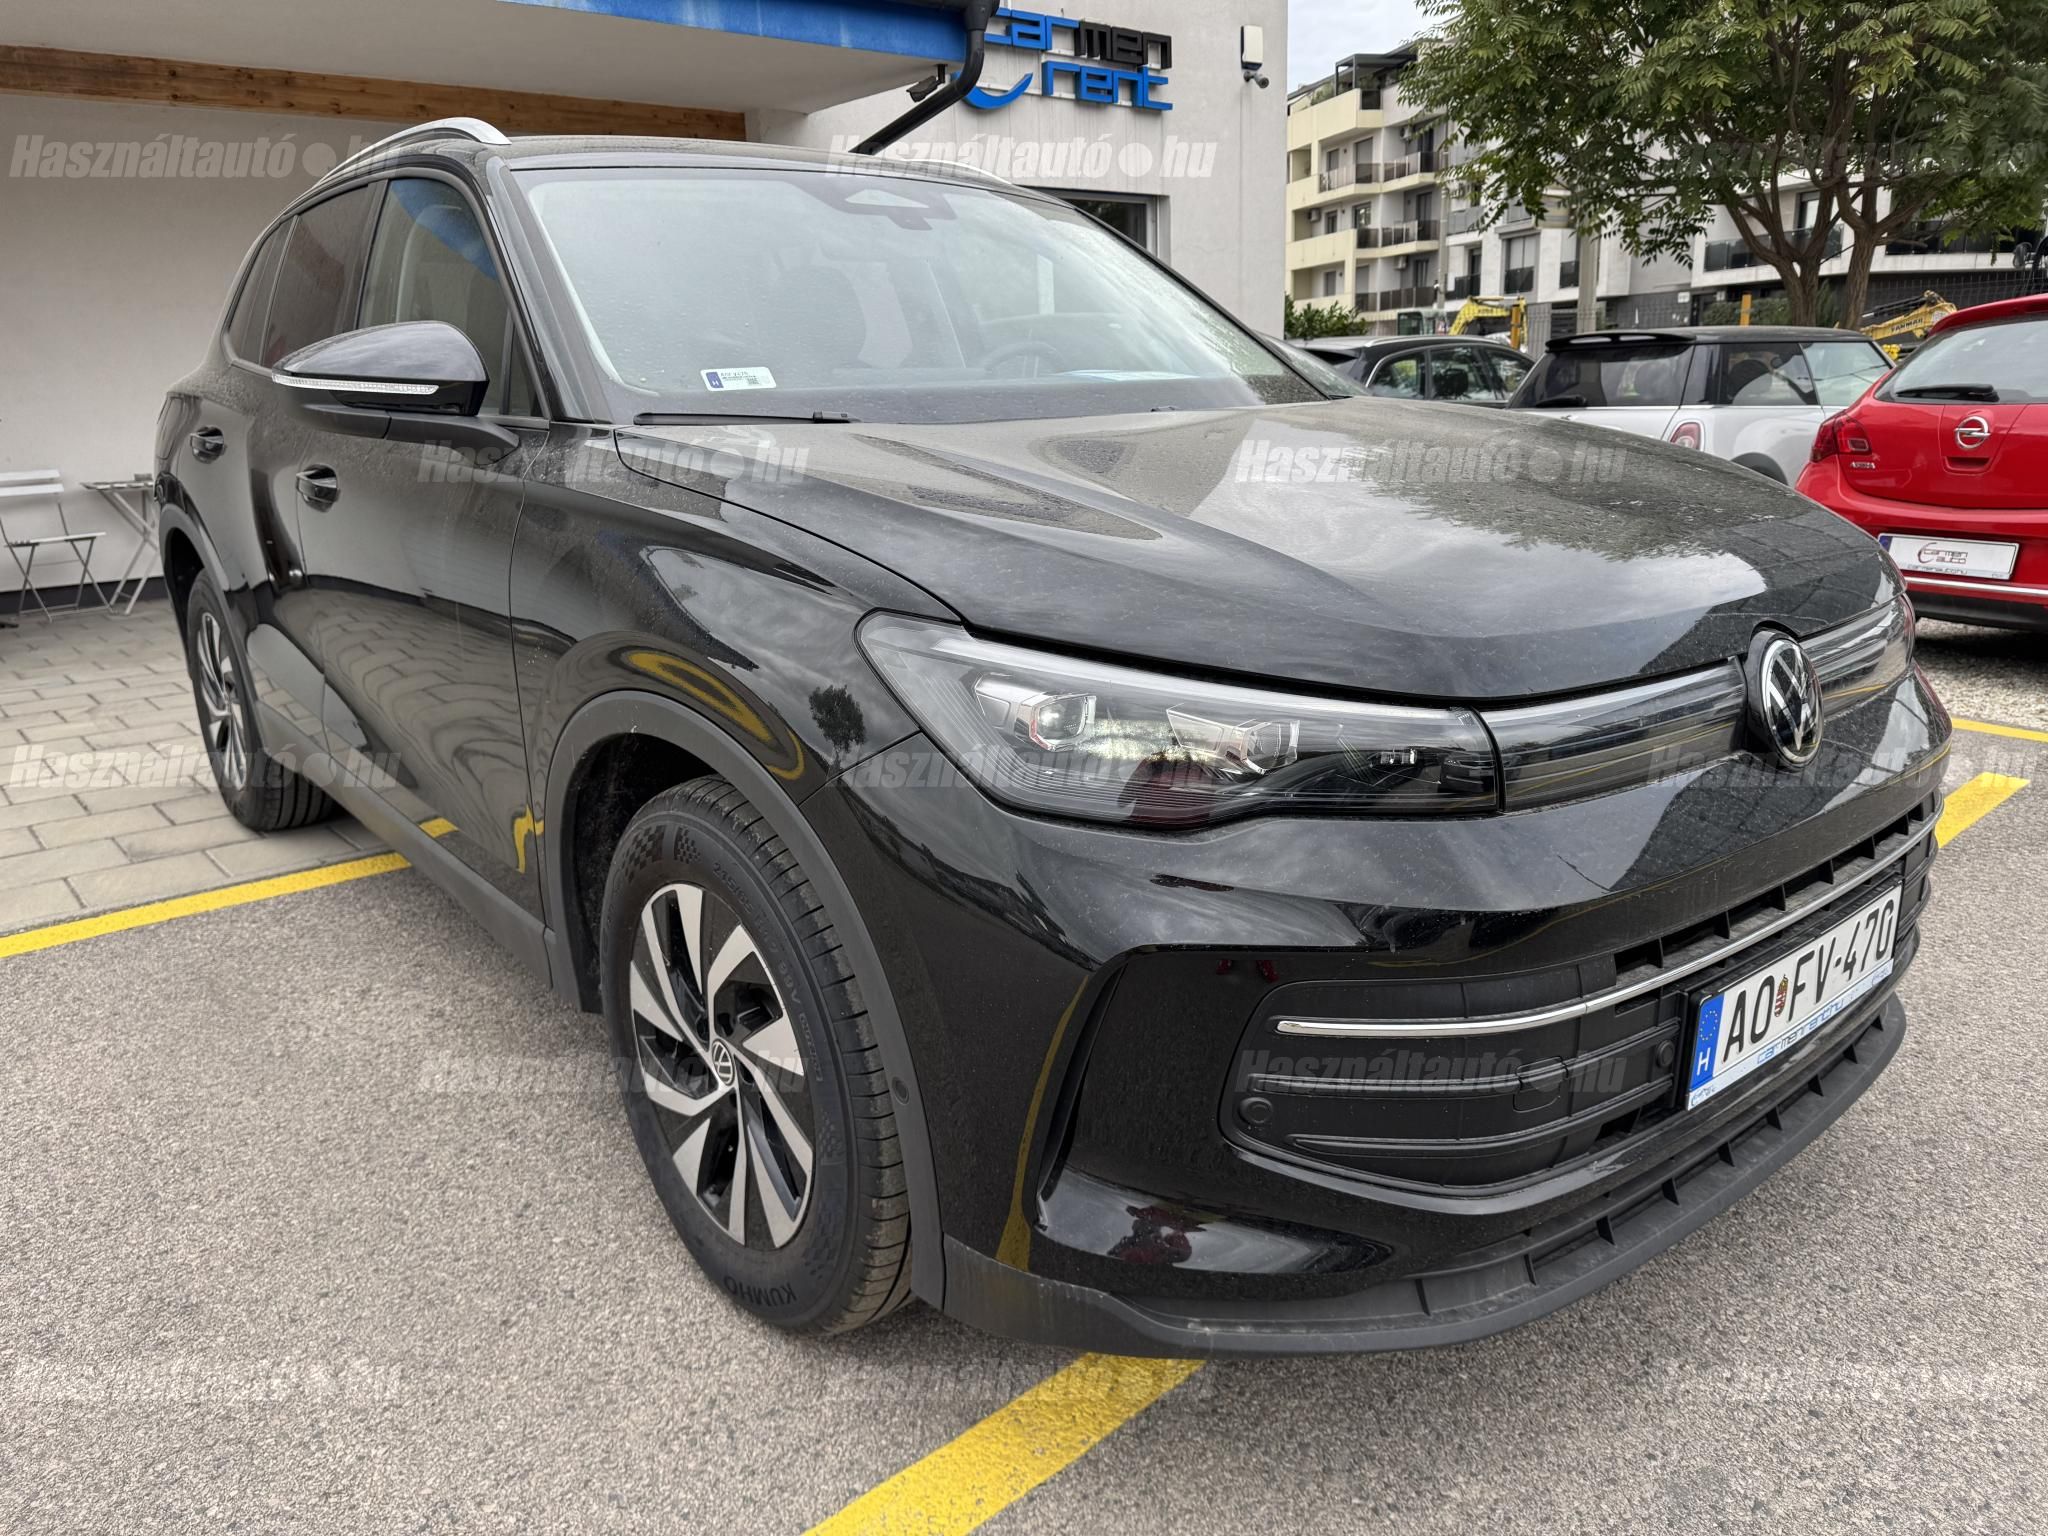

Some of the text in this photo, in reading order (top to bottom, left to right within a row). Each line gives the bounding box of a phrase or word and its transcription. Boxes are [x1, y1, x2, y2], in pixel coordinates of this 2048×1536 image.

[1042, 60, 1173, 111] rent
[1723, 898, 1894, 1063] AO FV-470
[1696, 1047, 1711, 1076] H
[723, 1274, 798, 1307] KUMHO
